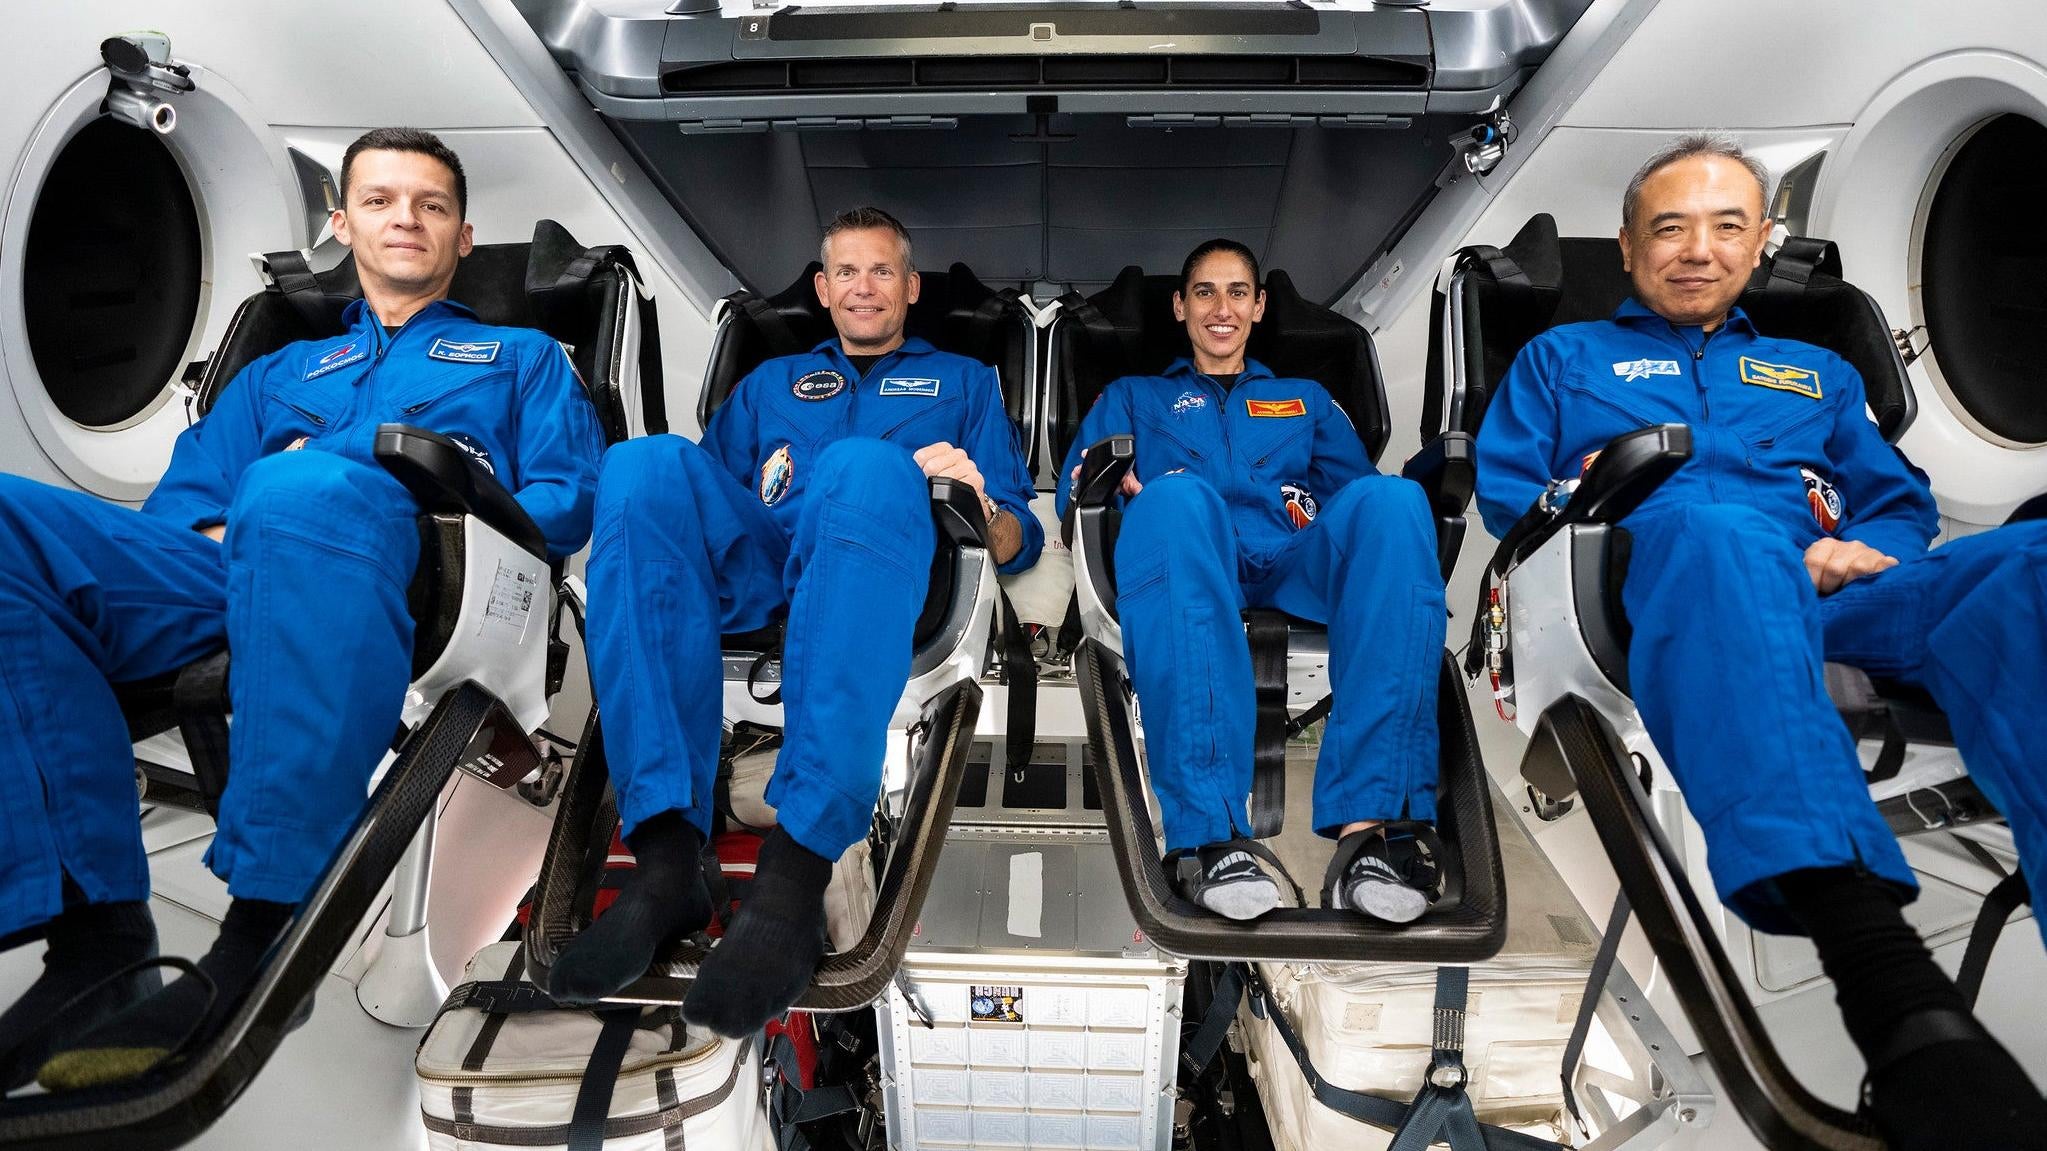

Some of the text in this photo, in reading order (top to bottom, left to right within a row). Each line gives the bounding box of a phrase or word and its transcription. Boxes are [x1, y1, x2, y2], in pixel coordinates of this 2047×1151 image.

[750, 22, 758, 33] 8
[306, 352, 365, 379] РОСКОСМОС
[1626, 360, 1677, 373] JAXA
[1173, 397, 1205, 412] NASA
